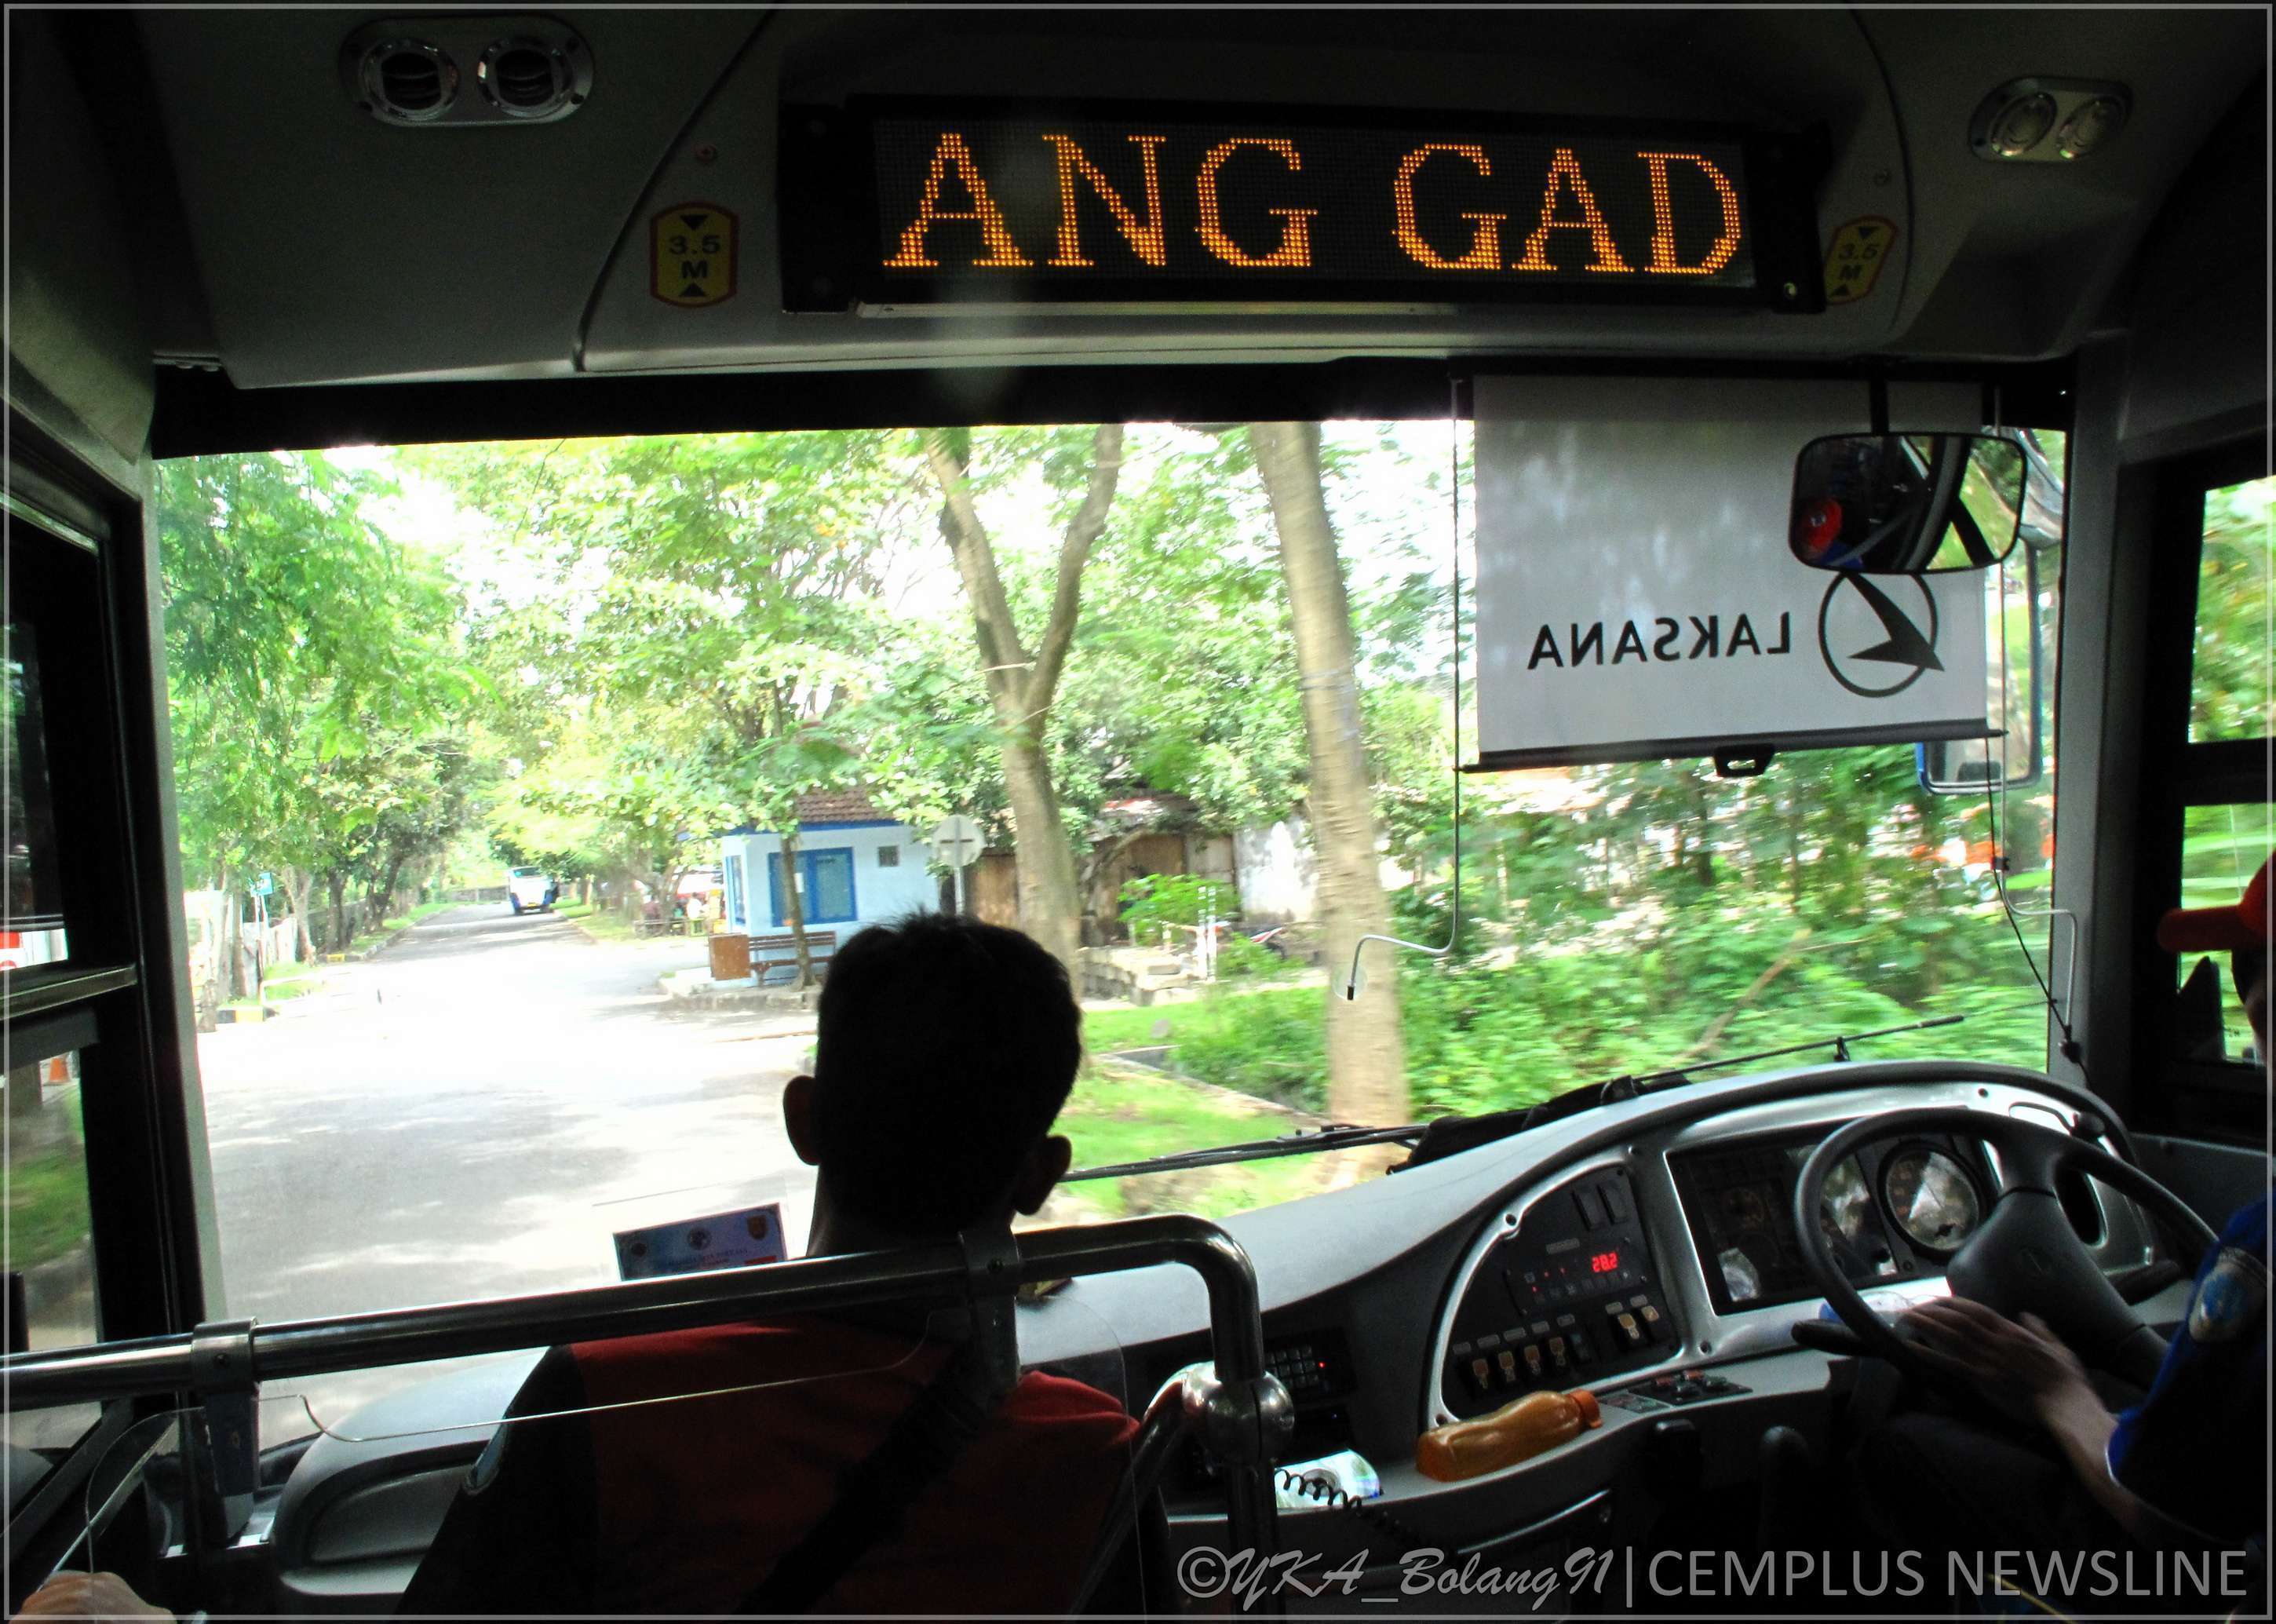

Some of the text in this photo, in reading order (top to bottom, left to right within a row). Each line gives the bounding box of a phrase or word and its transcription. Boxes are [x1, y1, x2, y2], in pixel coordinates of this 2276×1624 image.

[882, 133, 1743, 276] ANG GAD
[668, 234, 721, 256] 3.5
[1837, 243, 1880, 260] 3.5
[680, 260, 709, 279] M
[1839, 264, 1864, 281] M
